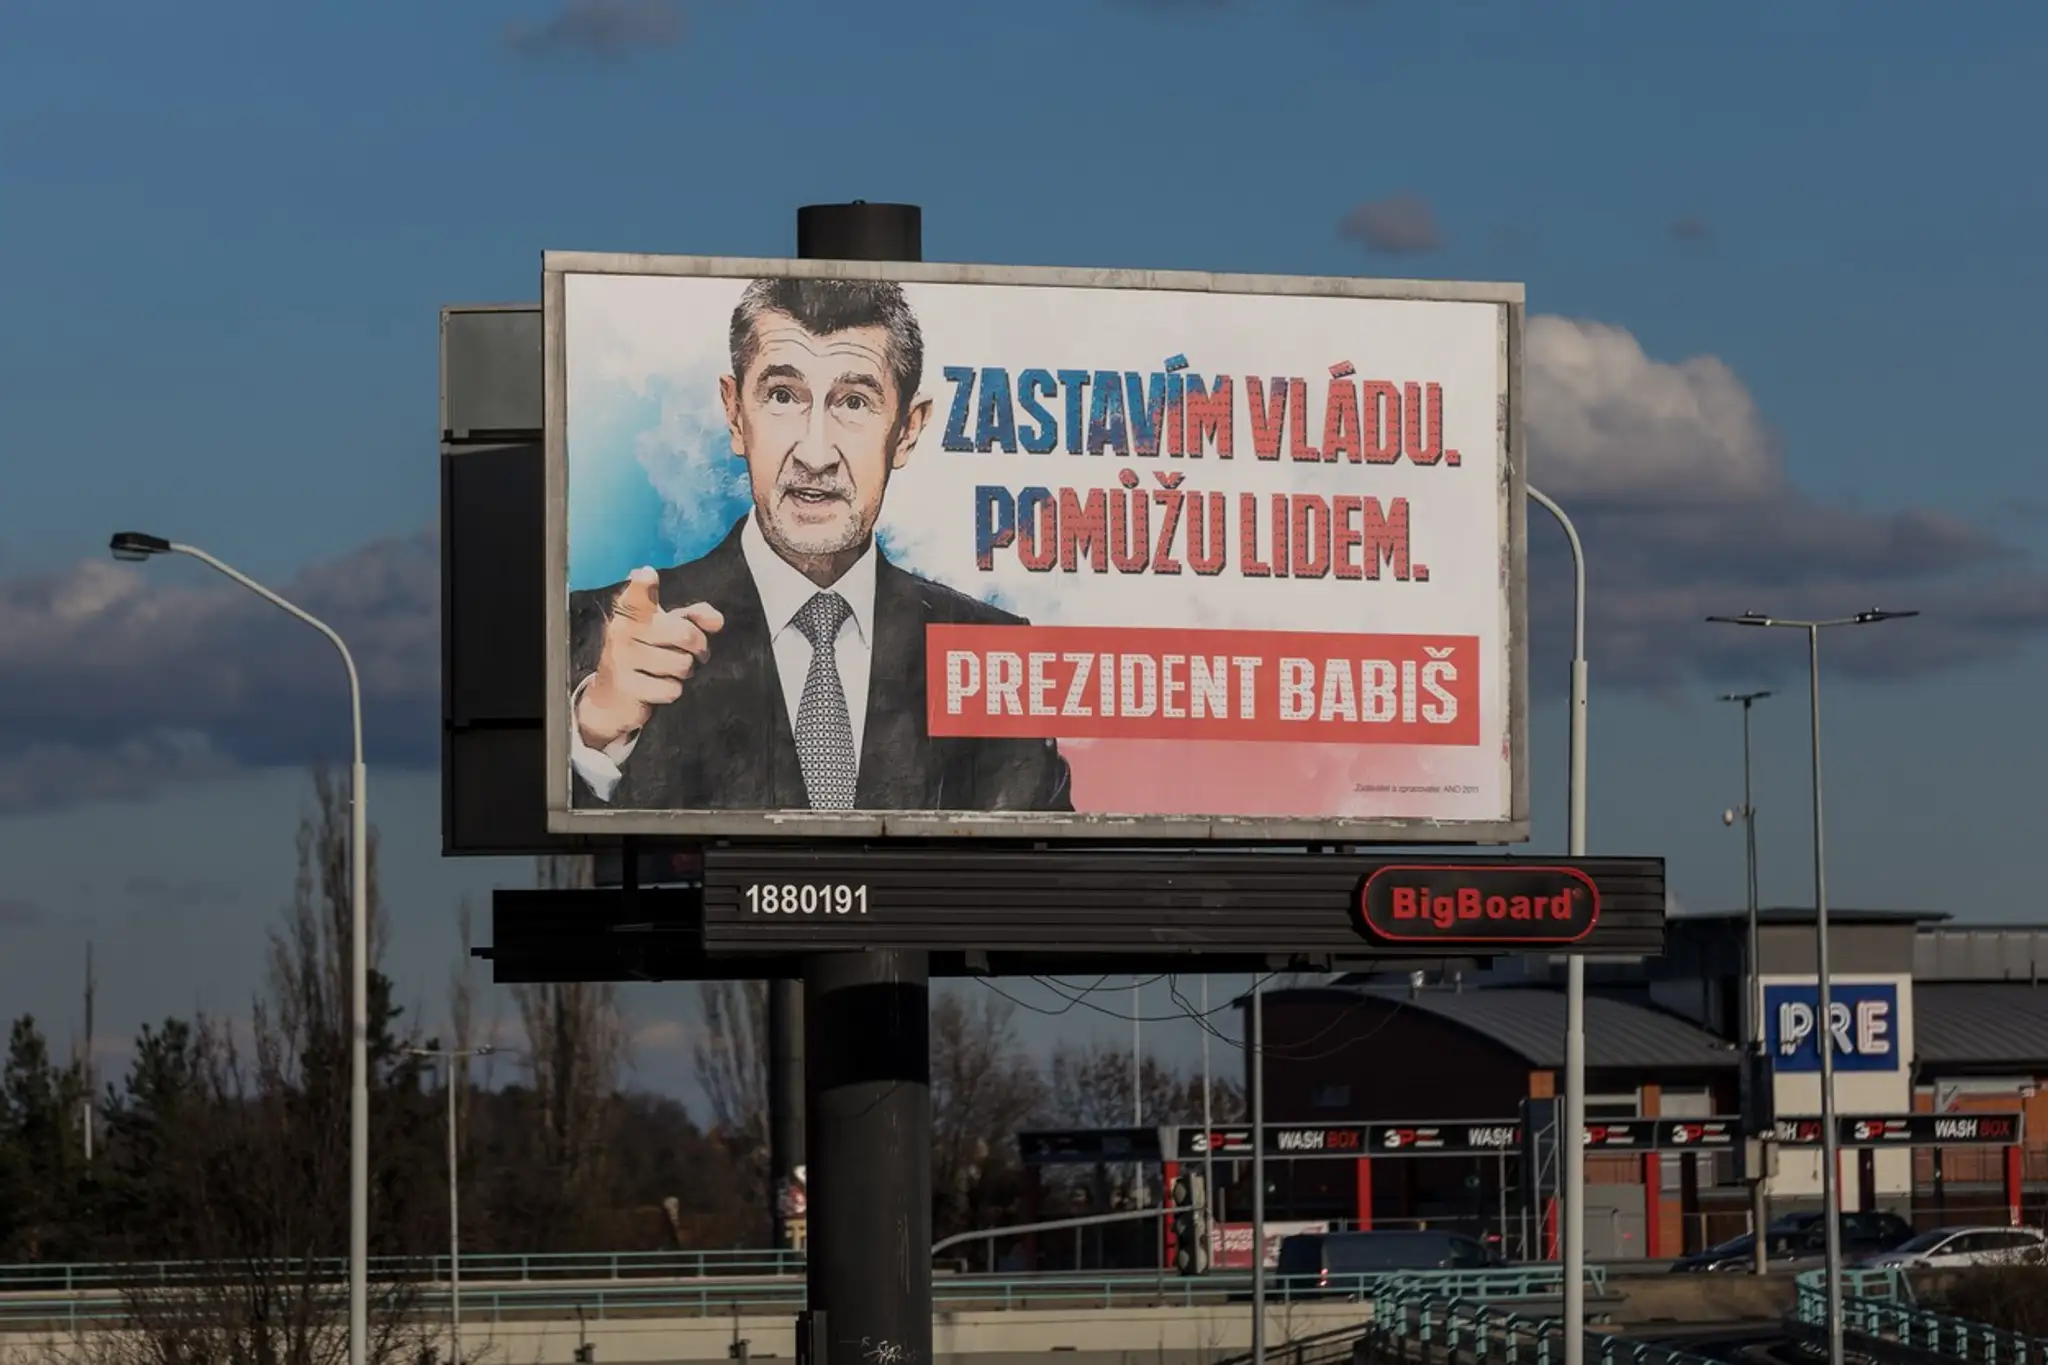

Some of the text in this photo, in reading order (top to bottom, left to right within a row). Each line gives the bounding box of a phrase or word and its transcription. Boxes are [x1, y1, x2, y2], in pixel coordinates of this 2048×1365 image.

[941, 353, 1461, 467] ZASTAVÍM VLÁDU.
[975, 468, 1430, 582] POMŮŽU LIDEM.
[946, 646, 1458, 725] PREZIDENT BABIŠ
[745, 884, 867, 914] 1880191
[1779, 1001, 1890, 1055] PRE
[1277, 1130, 1325, 1150] WASH
[1326, 1130, 1361, 1149] BOX
[1468, 1127, 1514, 1147] WASH
[1934, 1119, 1978, 1138] WASH
[1979, 1119, 2011, 1137] BOX
